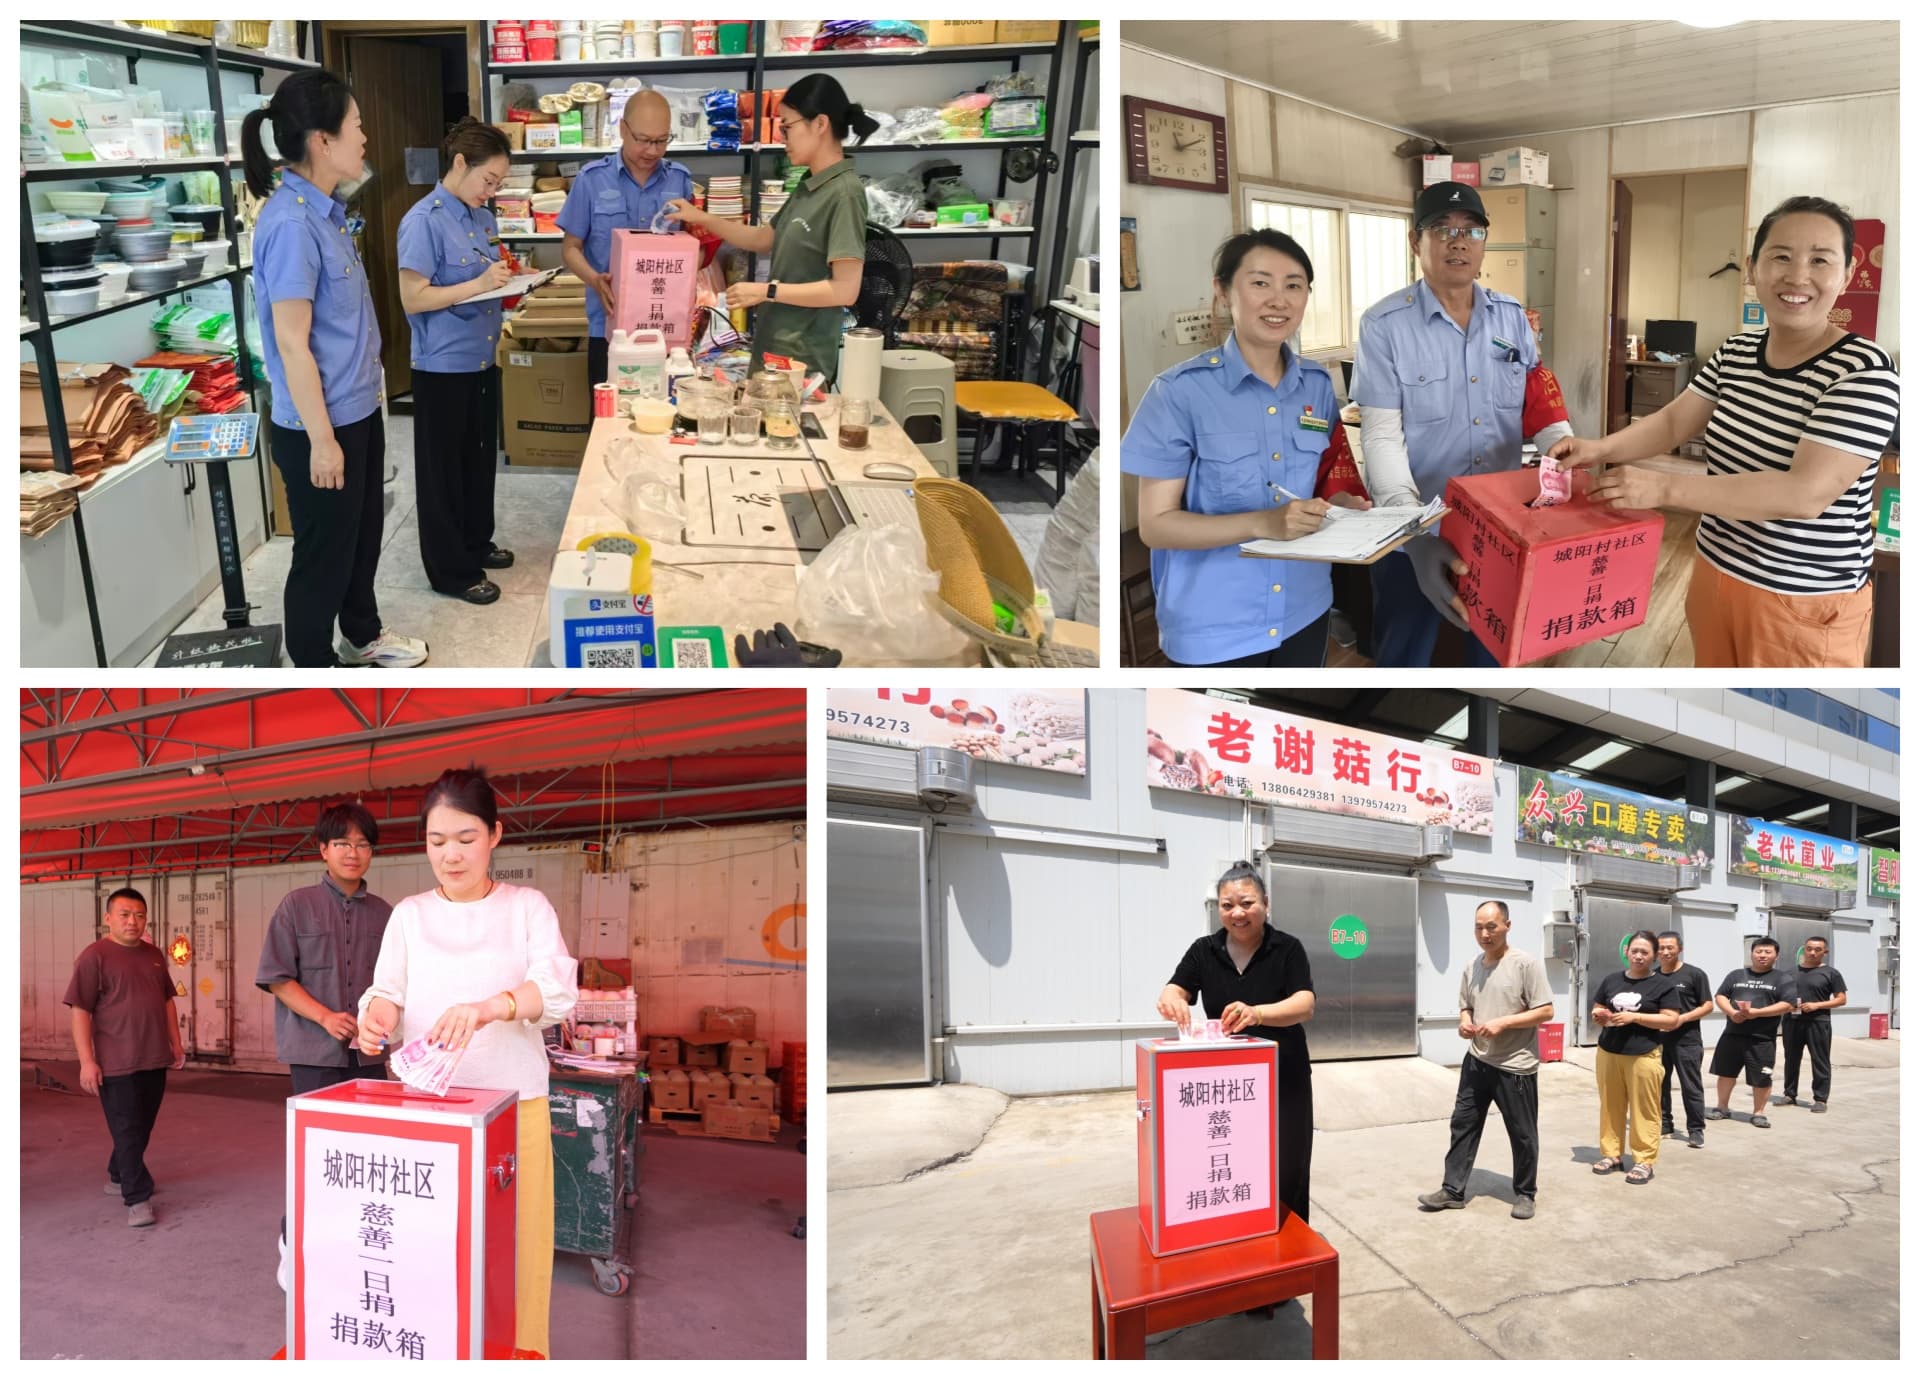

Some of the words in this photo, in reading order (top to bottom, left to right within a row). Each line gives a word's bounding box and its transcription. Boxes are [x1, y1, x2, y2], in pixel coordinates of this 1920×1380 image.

[635, 258, 684, 275] 城阳村社区
[1451, 496, 1514, 567] 城阳村社区
[1553, 532, 1647, 564] 城阳村社区
[575, 624, 644, 637] 推荐使用支付宝
[1459, 583, 1508, 645] 款箱
[1541, 597, 1637, 640] 捐款箱
[1207, 711, 1422, 793] 老谢菇行
[1261, 782, 1335, 801] 13806429381
[1342, 795, 1407, 813] 13979574273
[1756, 831, 1835, 872] 老代菌业
[1332, 929, 1367, 945] B7-10
[1179, 1077, 1256, 1109] 城阳村社区
[1207, 1109, 1232, 1183] 慈善一日捐
[323, 1147, 436, 1200] 城阳村社区
[1186, 1182, 1252, 1210] 捐款箱
[357, 1201, 396, 1318] 慈善一日捐
[329, 1311, 426, 1360] 捐款箱
